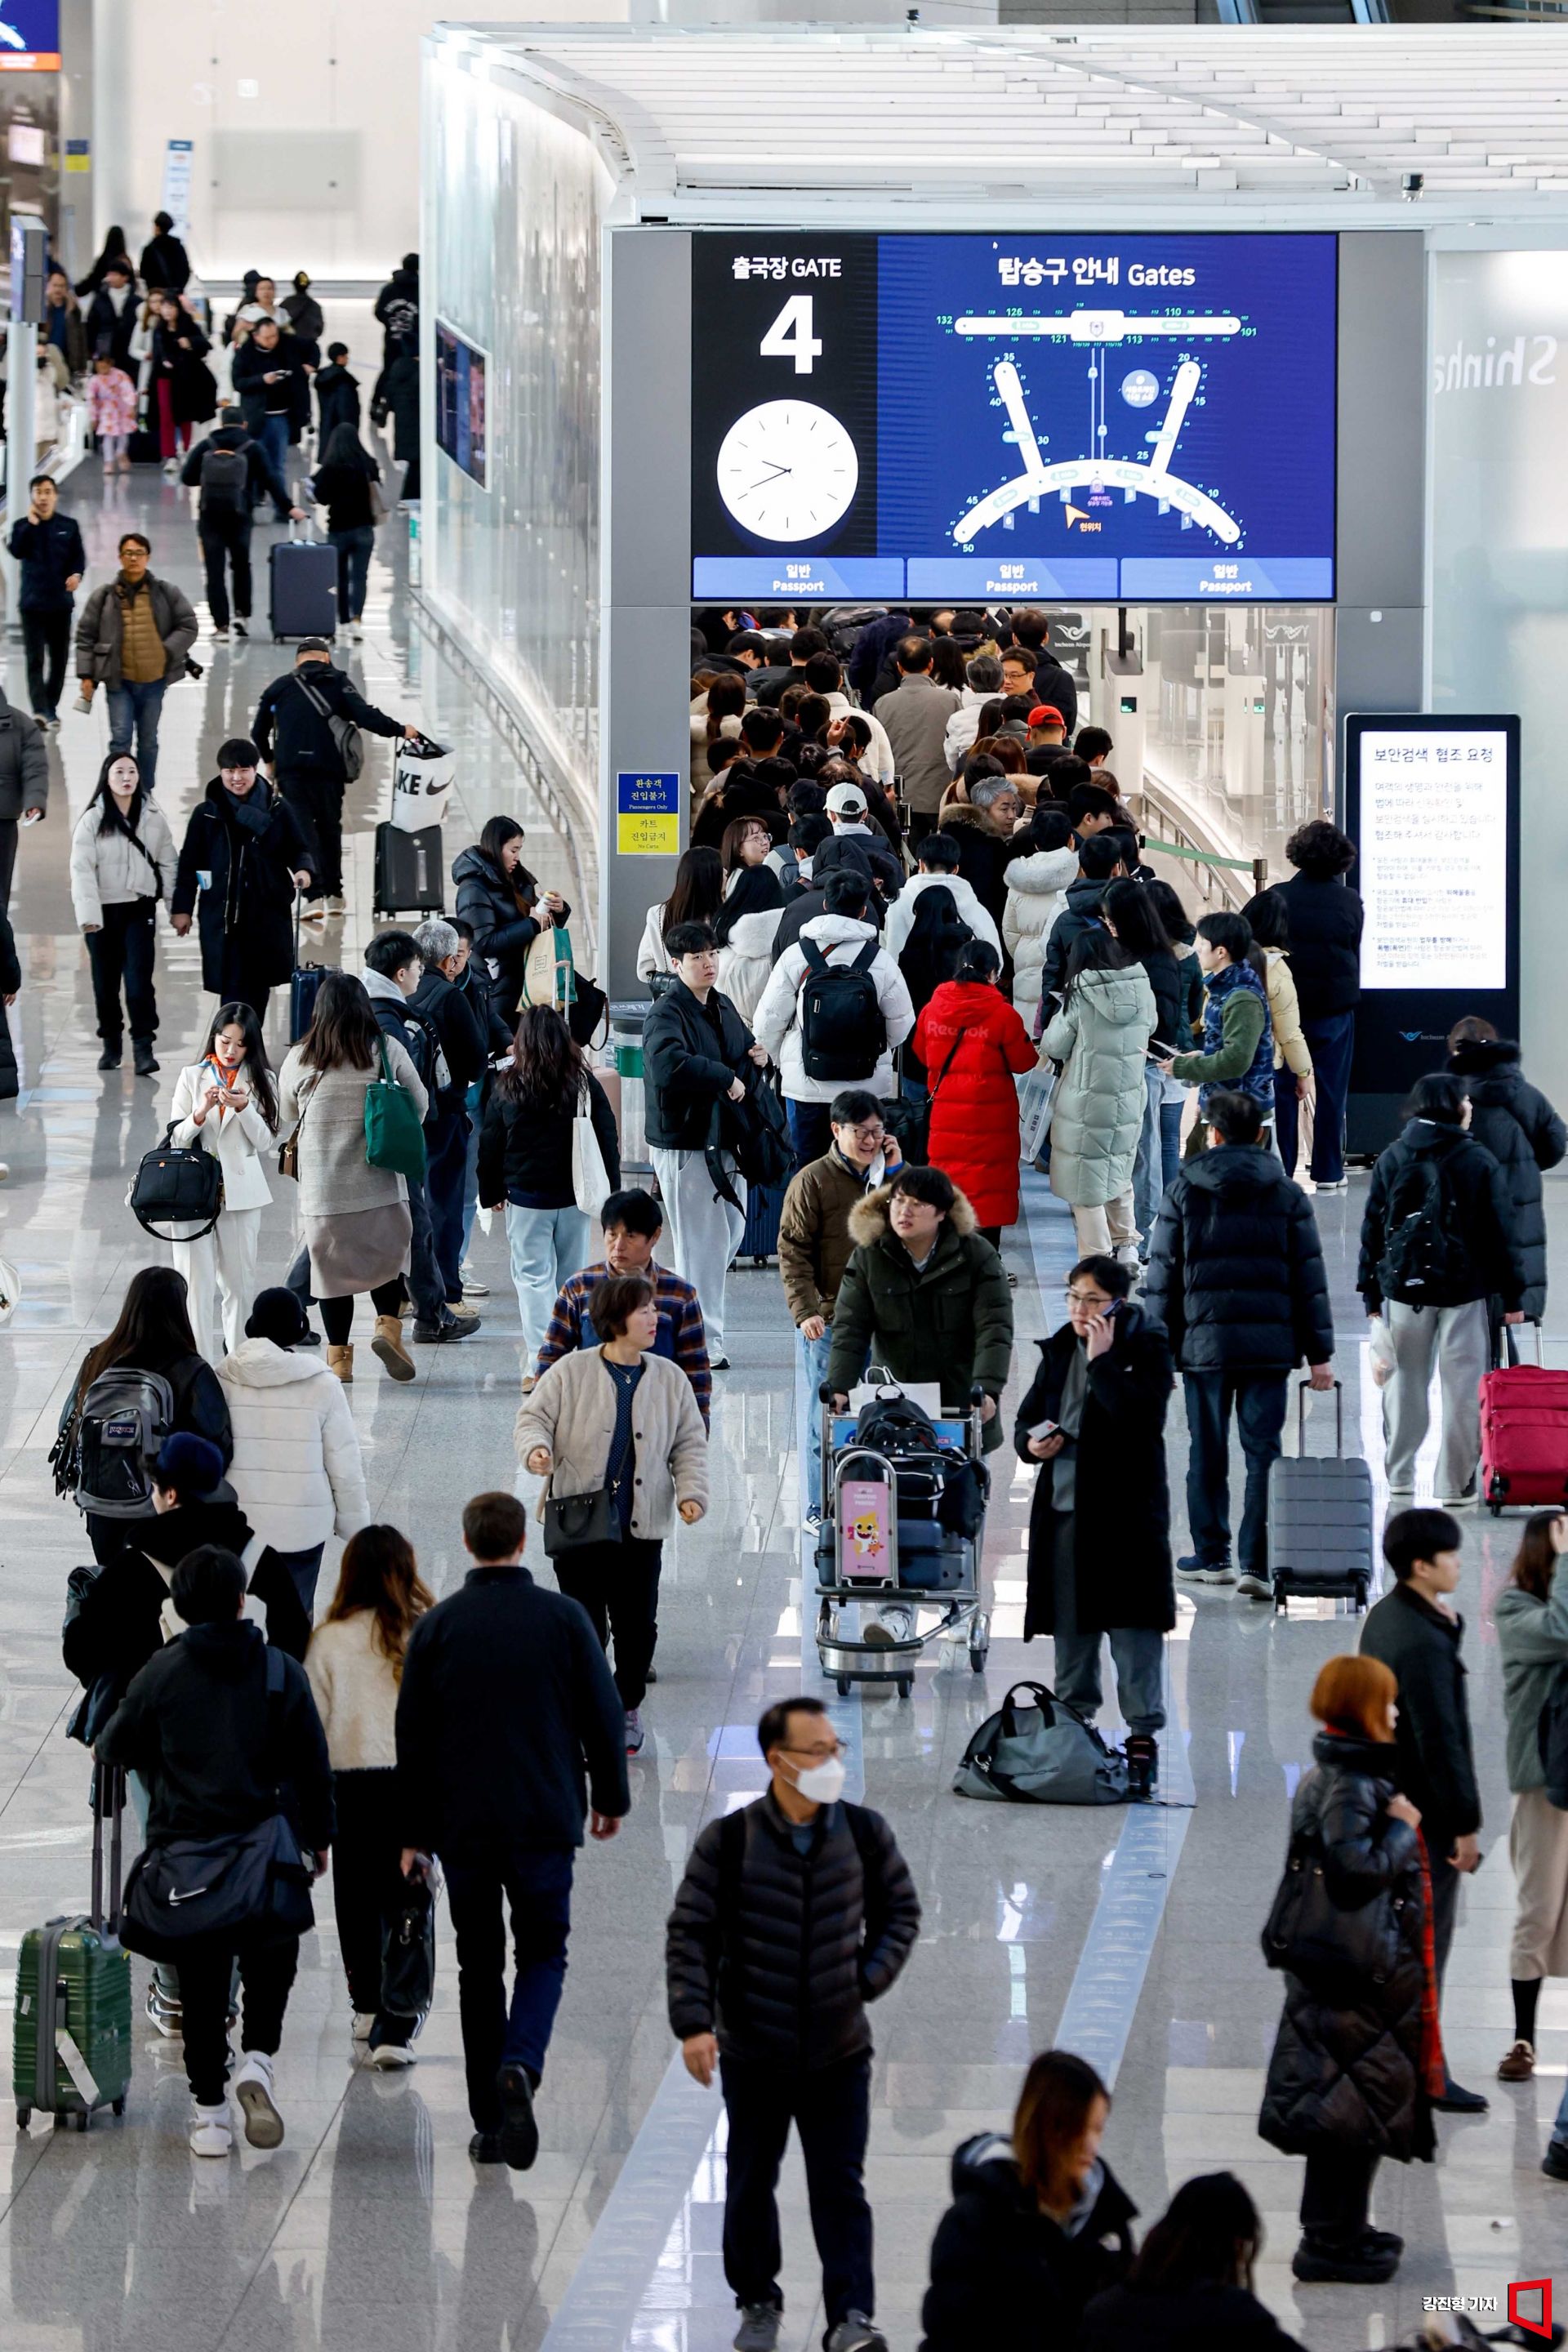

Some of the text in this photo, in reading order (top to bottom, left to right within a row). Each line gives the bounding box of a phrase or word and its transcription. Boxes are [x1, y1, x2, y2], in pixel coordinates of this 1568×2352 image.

[732, 256, 842, 279] 출국장 GATE
[998, 256, 1196, 286] 탑승구 안내 Gates
[1006, 308, 1022, 317] 126
[1165, 308, 1181, 316] 110
[937, 316, 952, 324] 132
[760, 295, 822, 374] 4
[1241, 327, 1257, 336] 101
[1051, 335, 1067, 343] 121
[1126, 335, 1143, 344] 113
[1003, 353, 1015, 361] 35
[1178, 354, 1190, 363] 20
[989, 398, 1002, 407] 40
[1194, 396, 1206, 406] 15
[1037, 436, 1049, 444] 30
[1136, 451, 1148, 460] 25
[1208, 488, 1219, 497] 10
[966, 496, 978, 505] 45
[962, 544, 974, 553] 50
[1236, 541, 1244, 550] 5
[786, 564, 811, 578] 일반
[999, 564, 1025, 578] 일반
[1214, 564, 1239, 579] 일반
[773, 581, 824, 595] Passport
[986, 581, 1038, 595] Passport
[1200, 581, 1252, 595] Passport
[1374, 748, 1493, 763] 보안검색 협조 요청
[631, 791, 666, 800] 진입불가
[639, 819, 657, 828] 카트
[632, 832, 666, 841] 진입금지
[928, 1021, 989, 1038] Reeok
